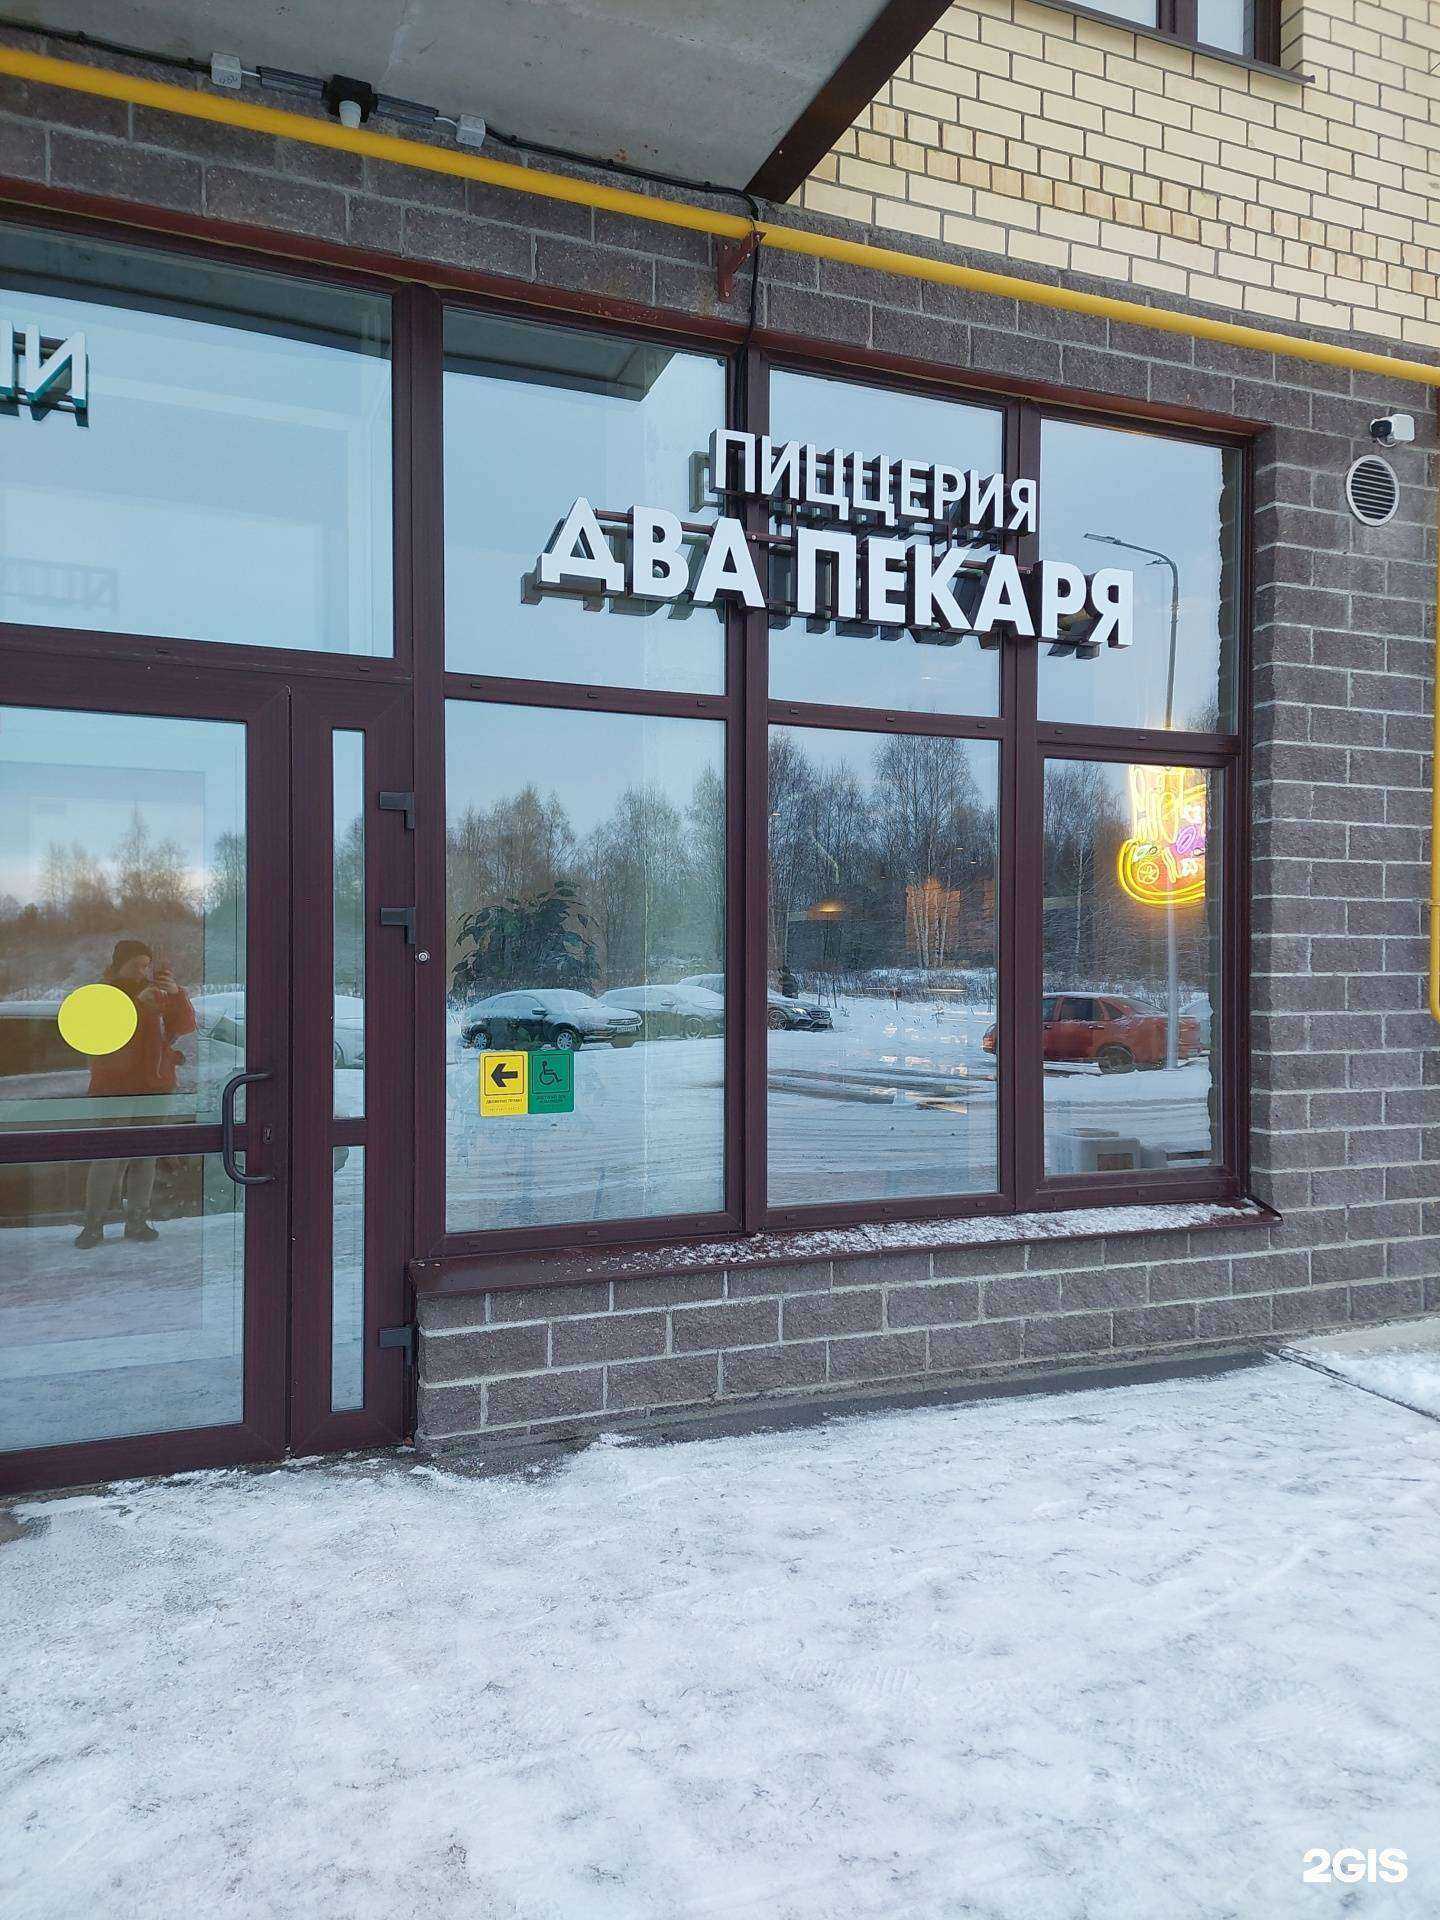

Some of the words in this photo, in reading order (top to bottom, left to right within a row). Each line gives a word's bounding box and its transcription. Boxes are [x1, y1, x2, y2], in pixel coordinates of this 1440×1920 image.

[713, 428, 1037, 533] ПИЦЦЕРИЯ
[541, 496, 766, 608] ДВА
[797, 526, 1135, 649] ПЕКАРЯ
